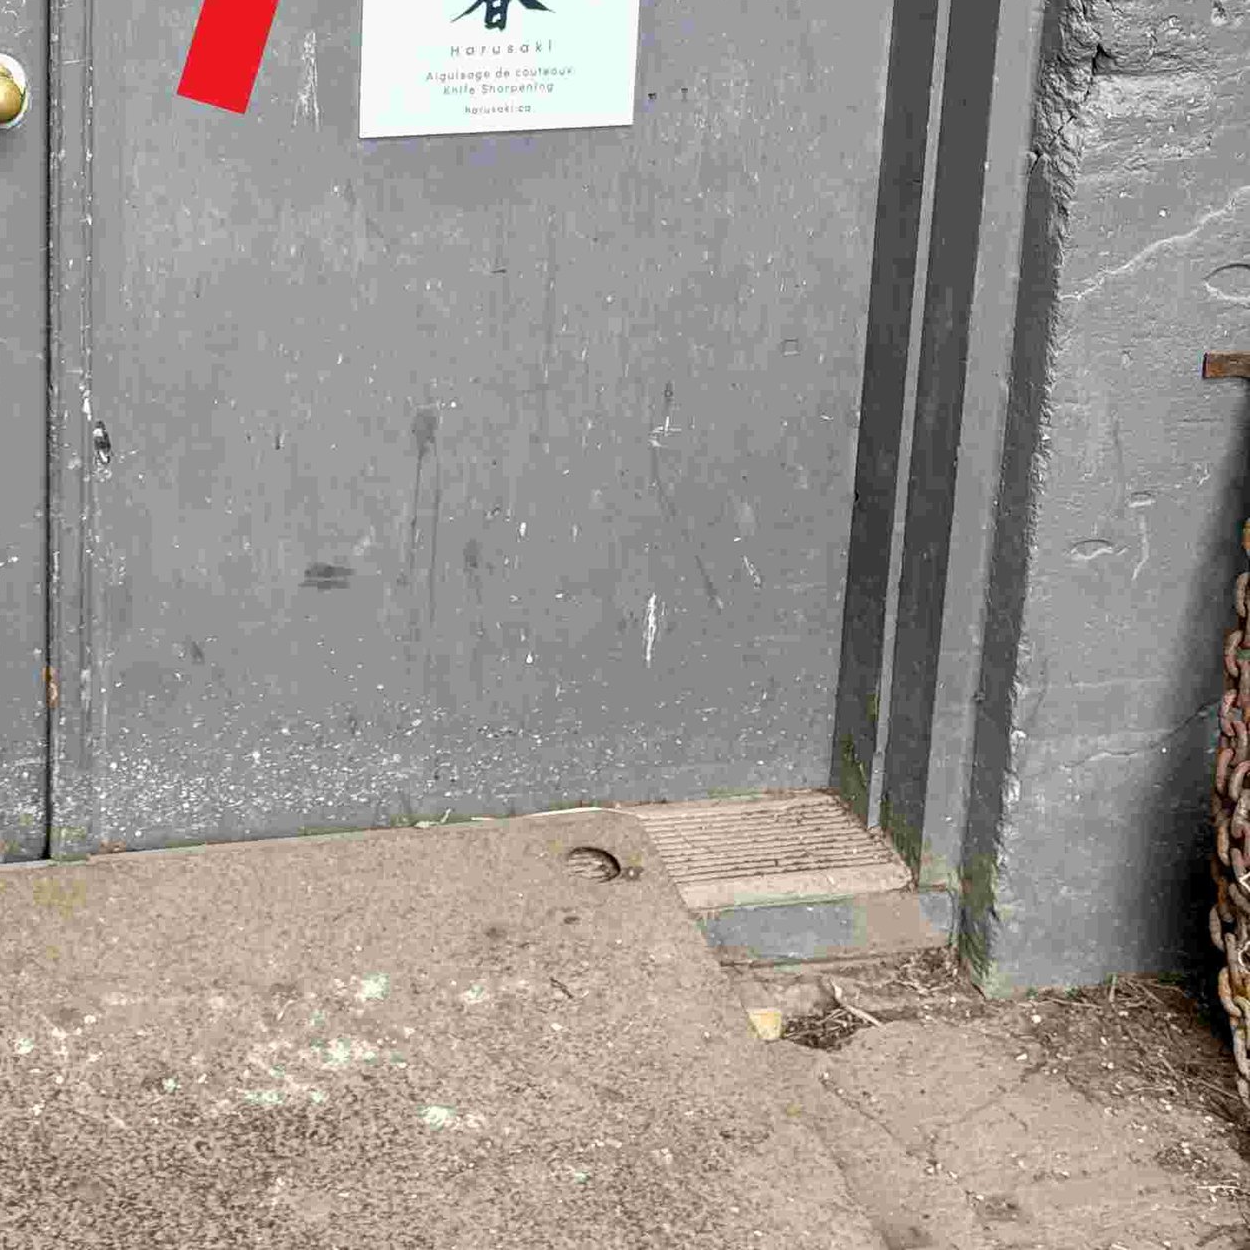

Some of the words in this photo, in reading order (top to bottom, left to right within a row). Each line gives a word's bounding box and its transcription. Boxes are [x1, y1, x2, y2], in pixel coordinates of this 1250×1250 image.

[450, 40, 553, 57] Harusaki
[426, 69, 490, 84] Aiguisage
[495, 67, 511, 78] de
[515, 66, 573, 78] couteaux
[443, 84, 476, 96] Knife
[481, 82, 554, 96] Sharpening
